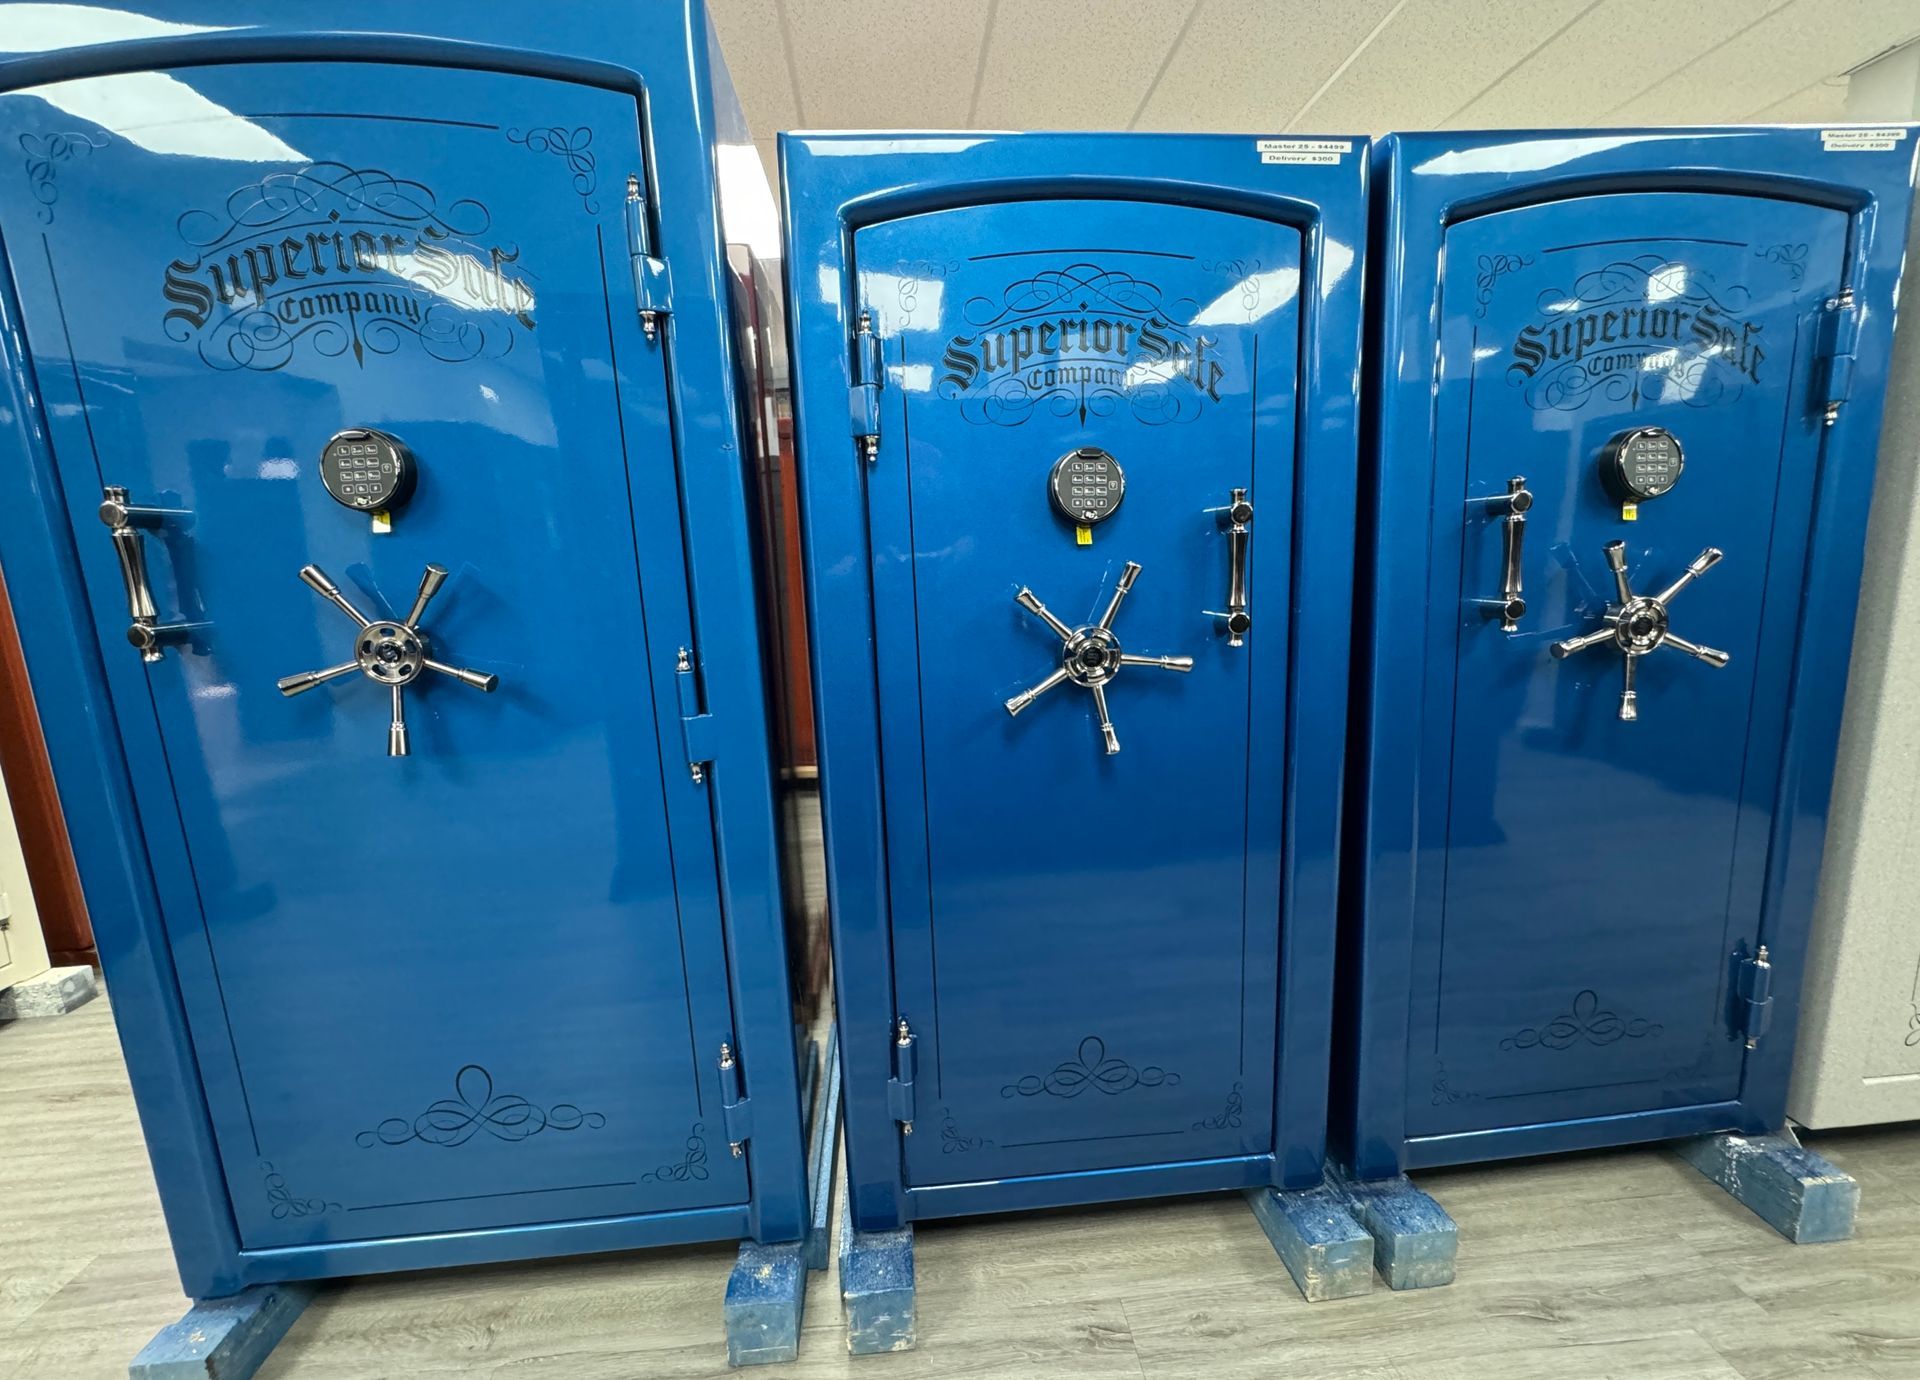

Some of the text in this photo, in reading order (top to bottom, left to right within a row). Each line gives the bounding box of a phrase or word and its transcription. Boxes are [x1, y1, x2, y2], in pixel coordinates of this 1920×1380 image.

[163, 224, 538, 331] Superior Safe
[941, 316, 1225, 404] Superior Safe
[1512, 303, 1765, 385] Superior Safe
